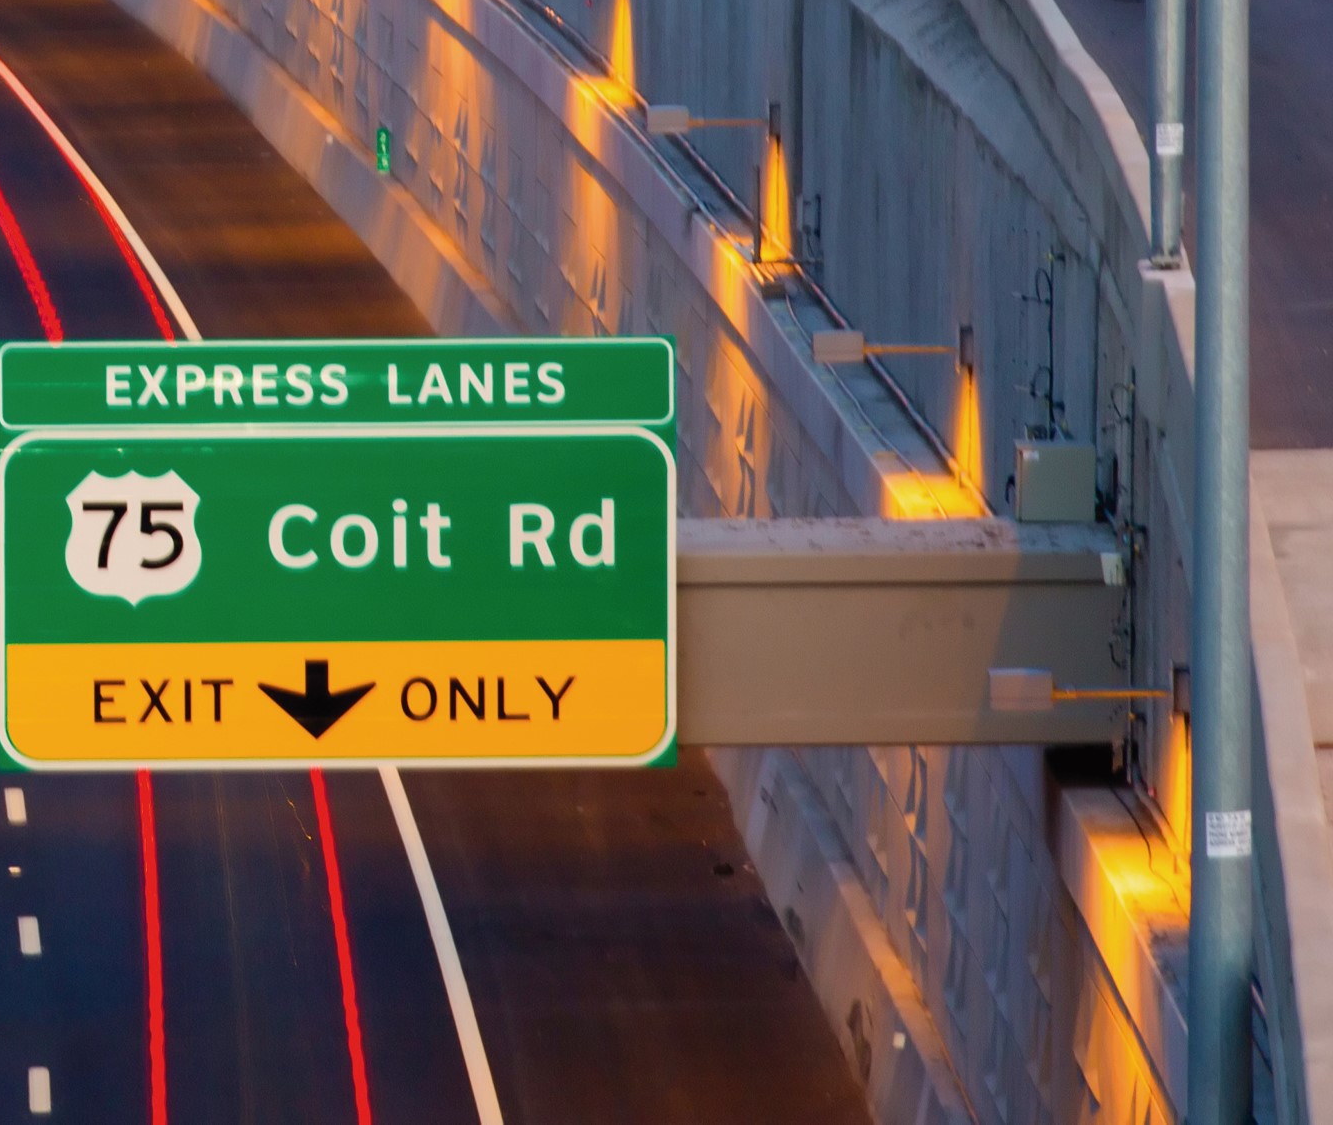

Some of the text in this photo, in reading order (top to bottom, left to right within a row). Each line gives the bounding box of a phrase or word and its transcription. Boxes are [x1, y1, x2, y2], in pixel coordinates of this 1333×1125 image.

[104, 361, 567, 407] EXPRESS LANES
[82, 496, 617, 570] 75 Coit Rd
[93, 675, 576, 725] EXIT ONLY
